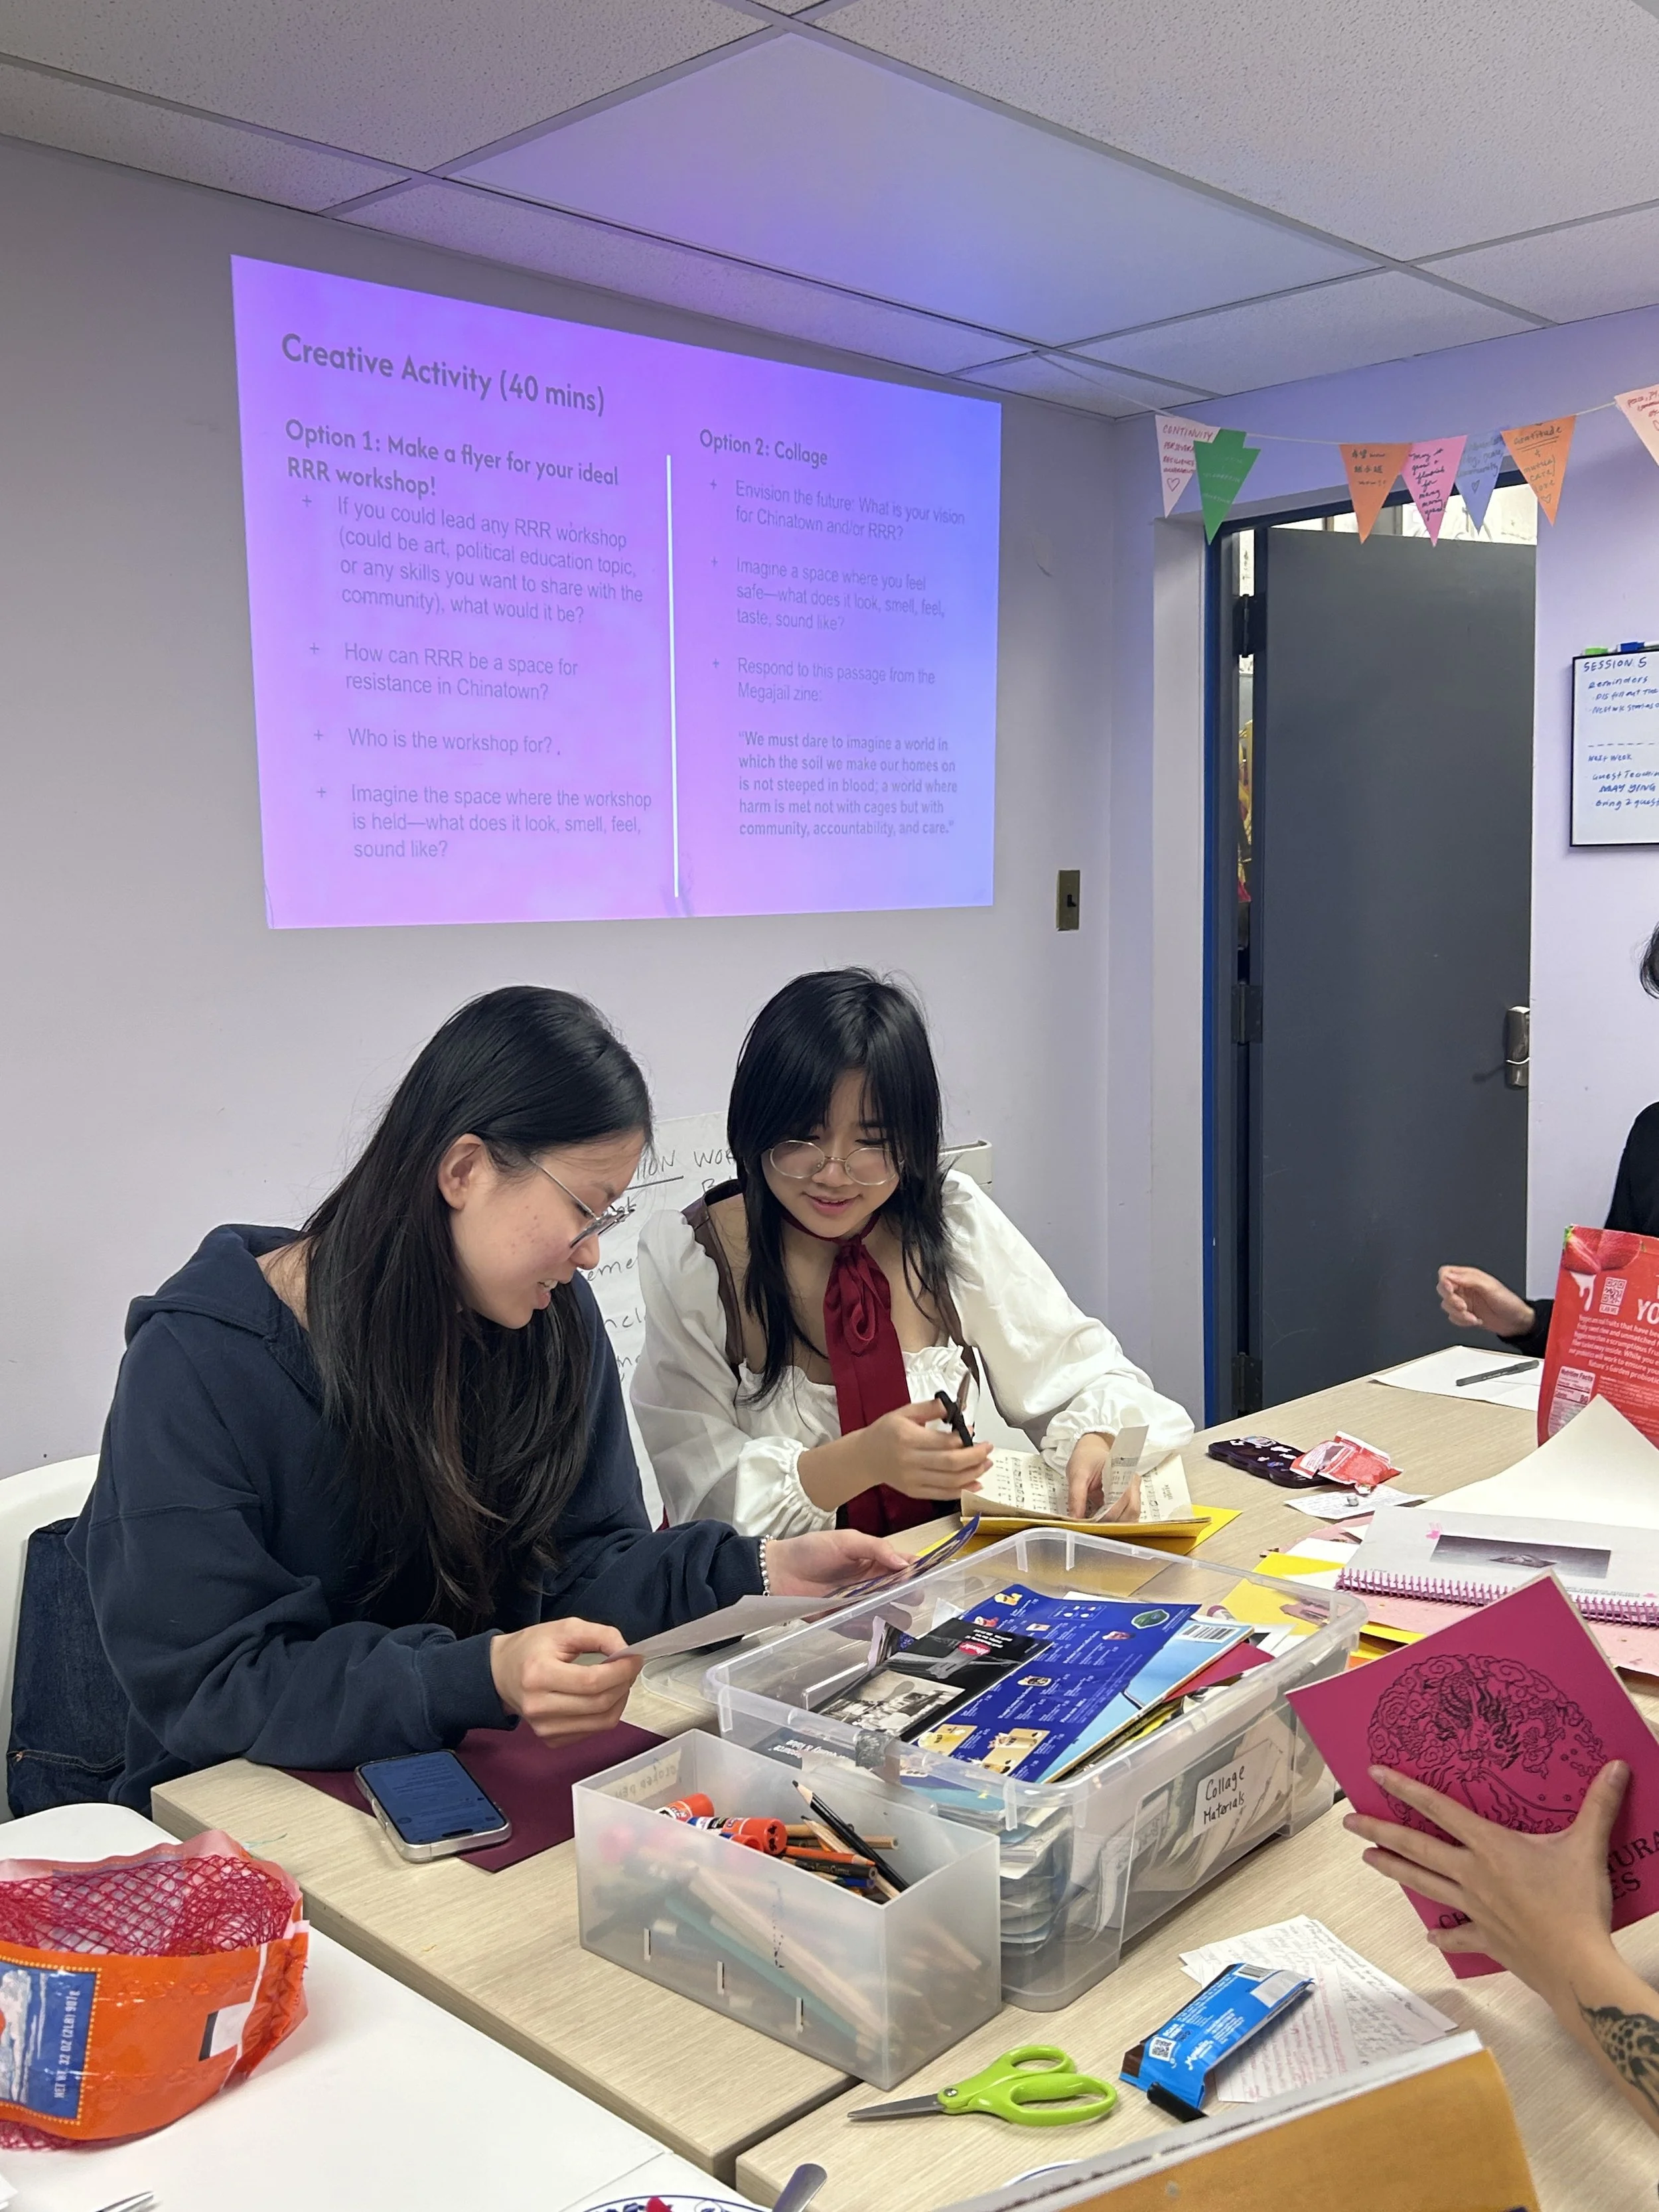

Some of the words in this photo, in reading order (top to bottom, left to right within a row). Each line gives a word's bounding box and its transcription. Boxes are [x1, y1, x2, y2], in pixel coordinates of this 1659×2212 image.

[282, 333, 394, 378] Creative
[401, 355, 492, 401] Activity
[500, 370, 538, 402] (40
[545, 384, 604, 417] mins)
[1163, 424, 1213, 442] CONTINUITY
[1514, 425, 1562, 445] Gratitude
[285, 419, 356, 449] Option
[362, 431, 380, 452] 1:
[388, 435, 439, 461] Make
[444, 449, 455, 463] a
[461, 444, 501, 472] flyer
[506, 451, 531, 473] for
[536, 462, 573, 480] your
[579, 463, 618, 485] ideal
[699, 429, 751, 454] Option
[755, 437, 769, 456] 2:
[774, 441, 828, 469] Collage
[288, 457, 330, 482] RRR
[336, 467, 435, 500] workshop!
[1421, 480, 1437, 492] for
[736, 479, 790, 502] Envision
[794, 488, 813, 506] the
[816, 490, 854, 511] future:
[859, 496, 889, 516] What
[893, 501, 902, 518] is
[904, 506, 930, 522] your
[933, 507, 965, 524] vision
[338, 496, 349, 515] If
[354, 502, 386, 522] you
[391, 506, 436, 526] could
[441, 509, 476, 530] lead
[480, 518, 509, 538] any
[515, 518, 551, 540] RRR
[556, 525, 626, 552] workshop
[736, 504, 754, 523] for
[757, 508, 823, 532] Chinatown
[827, 520, 865, 536] and/or
[868, 522, 904, 540] RRR?
[339, 526, 392, 550] (could
[397, 532, 419, 552] be
[424, 538, 449, 558] art,
[456, 541, 515, 563] political
[520, 548, 593, 571] education
[598, 557, 636, 578] topic,
[737, 557, 787, 579] Imagine
[790, 566, 798, 579] a
[802, 567, 839, 583] space
[842, 569, 878, 587] where
[881, 575, 902, 591] you
[906, 573, 926, 591] feel
[342, 589, 445, 615] community),
[450, 595, 489, 615] what
[493, 601, 539, 619] would
[543, 603, 553, 621] it
[557, 605, 584, 623] be?
[811, 589, 841, 607] does
[844, 593, 851, 608] it
[854, 593, 881, 613] look,
[885, 598, 918, 616] smell,
[921, 598, 945, 619] feel,
[737, 608, 772, 627] taste,
[776, 613, 813, 629] sound
[817, 615, 845, 630] like?
[344, 642, 383, 662] How
[388, 650, 419, 665] can
[425, 648, 464, 668] RRR
[469, 652, 488, 670] be
[494, 658, 503, 670] a
[508, 658, 553, 676] space
[558, 658, 578, 676] for
[737, 657, 794, 679] Respond
[797, 662, 809, 678] to
[812, 663, 833, 679] this
[837, 667, 886, 686] passage
[889, 666, 914, 683] from
[918, 668, 936, 685] the
[1583, 658, 1633, 672] SESSION
[346, 672, 432, 694] resistance
[437, 676, 451, 694] in
[457, 678, 549, 700] Chinatown?
[738, 682, 790, 703] Megajail
[793, 689, 822, 701] zine:
[348, 727, 388, 747] Who
[394, 729, 407, 748] is
[411, 731, 438, 749] the
[442, 733, 518, 756] workshop
[523, 735, 552, 753] for?
[352, 784, 418, 807] Imagine
[423, 786, 449, 804] the
[454, 790, 502, 808] space
[506, 788, 552, 806] where
[557, 790, 579, 806] the
[583, 790, 652, 811] workshop
[352, 812, 366, 830] is
[469, 814, 507, 832] does
[512, 814, 521, 832] it
[525, 814, 559, 834] look,
[565, 816, 607, 834] smell,
[611, 815, 641, 835] feel,
[739, 821, 810, 839] community,
[813, 821, 896, 838] accountability,
[899, 820, 919, 834] and
[354, 840, 405, 858] sound
[411, 840, 448, 857] like?
[1206, 1766, 1244, 1801] Collage
[1204, 1791, 1245, 1824] Materials
[58, 2054, 70, 2065] 32
[60, 2039, 72, 2051] OZ
